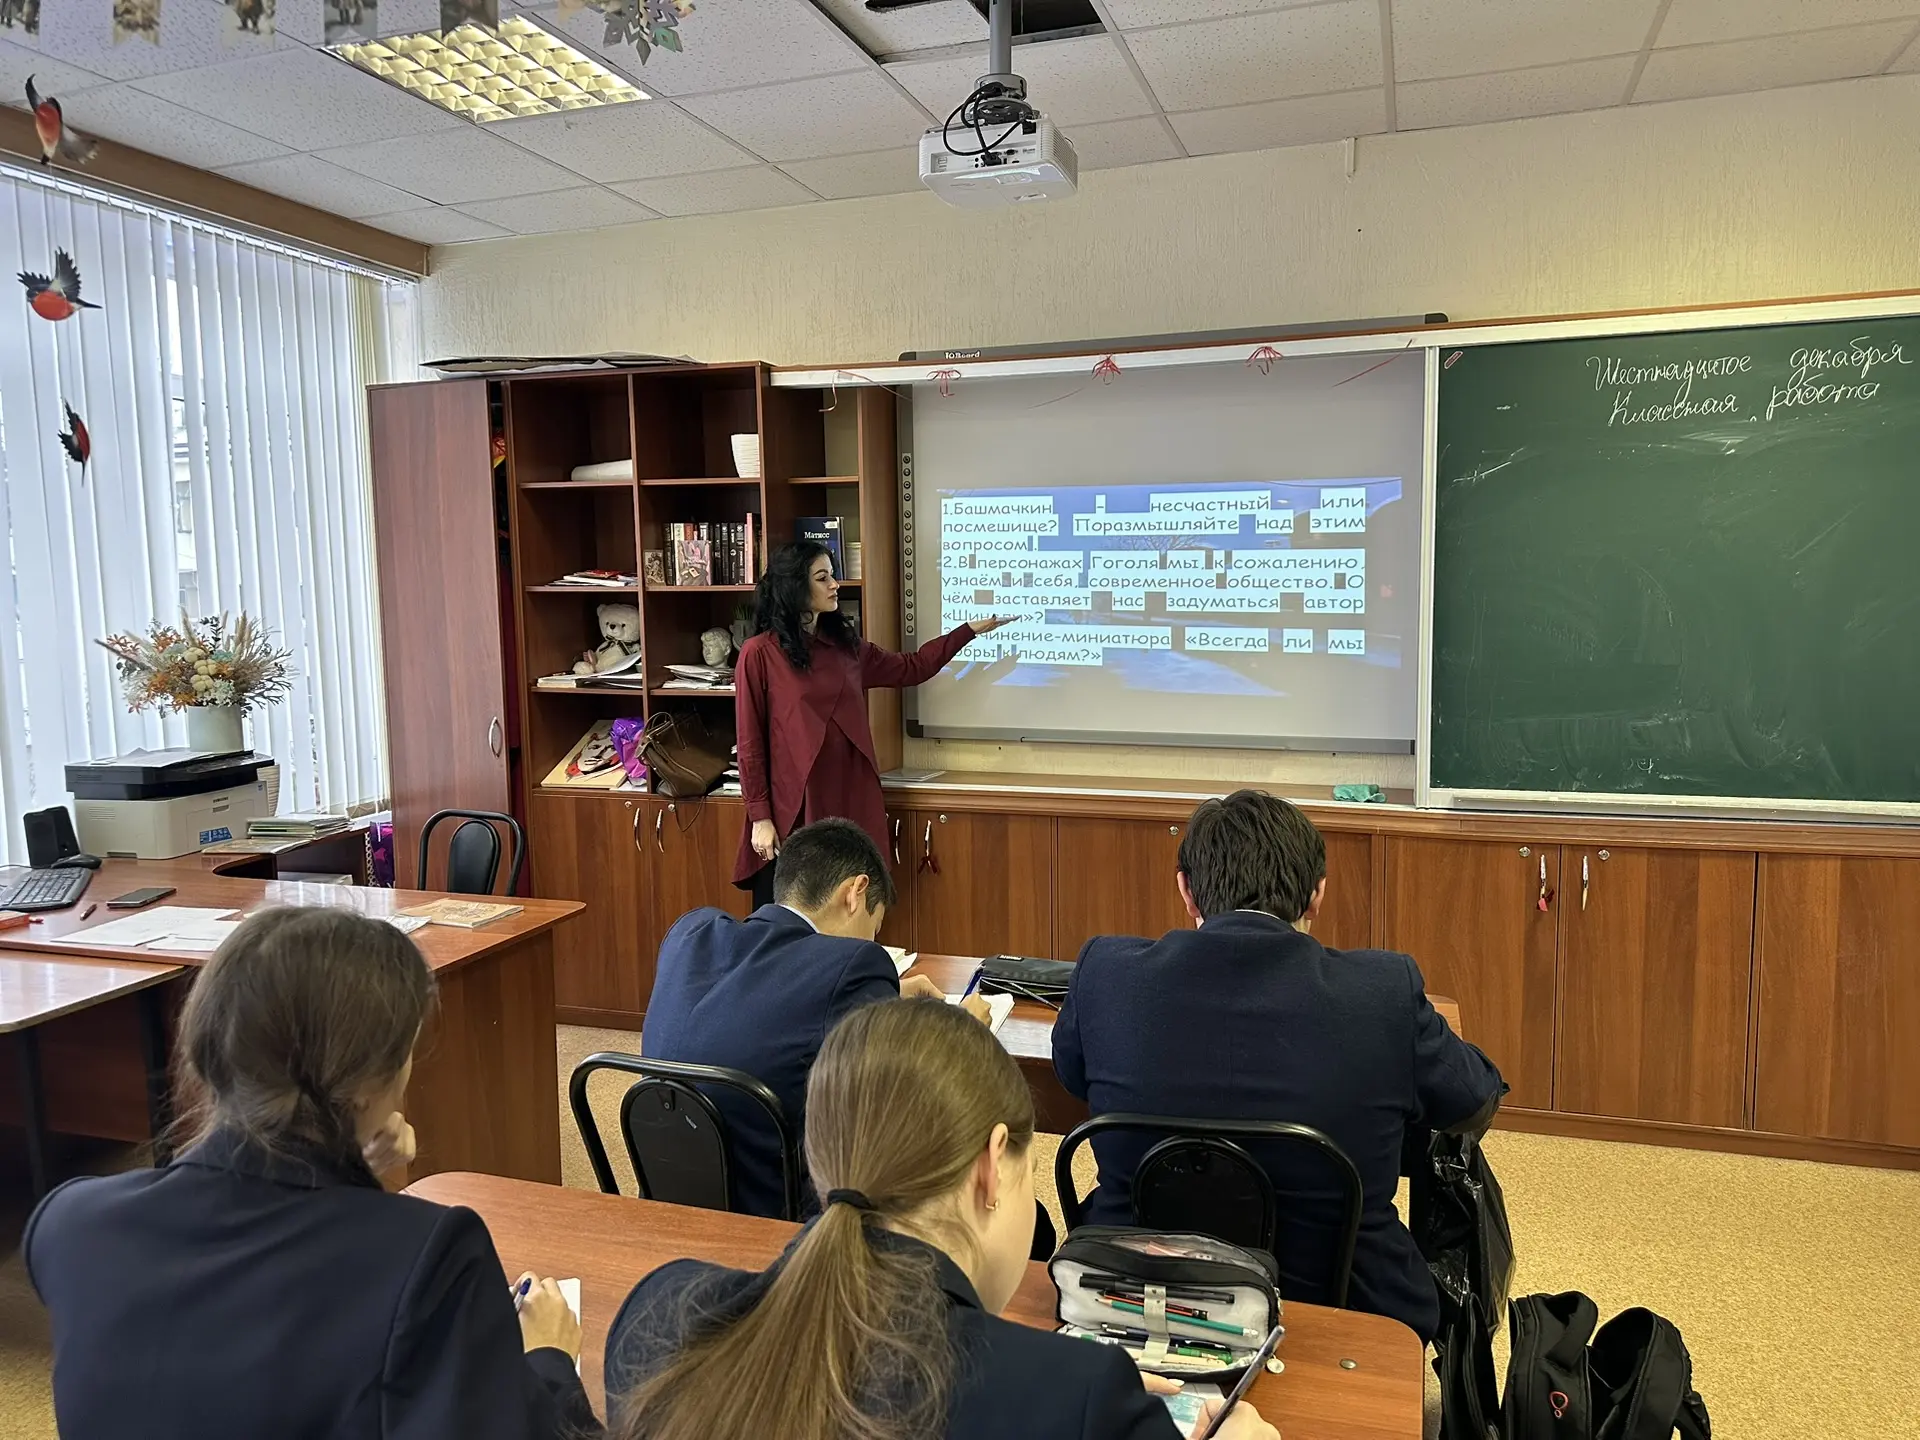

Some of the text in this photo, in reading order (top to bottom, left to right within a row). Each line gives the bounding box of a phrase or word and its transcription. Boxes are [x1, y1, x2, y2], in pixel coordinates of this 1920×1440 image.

[1788, 336, 1912, 390] декабря
[1767, 373, 1880, 420] работа
[942, 502, 1052, 515] 1.Башмачкин
[1150, 496, 1270, 512] несчастный
[1321, 497, 1364, 508] или
[943, 516, 1365, 535] посмешище? Поразмышляйте над этим
[804, 531, 830, 539] Матисс
[977, 558, 1082, 571] персонажах
[1092, 556, 1158, 569] Гоголя
[1168, 559, 1205, 570] мы,
[1214, 559, 1224, 568] к
[1233, 557, 1365, 570] сожалению,
[942, 574, 1364, 590] узнаём и себя, современное общество. О
[942, 591, 1364, 613] чём заставляет нас задуматься автор
[1186, 633, 1268, 648] «Всегда
[1284, 638, 1311, 648] ли
[1329, 639, 1364, 650] мы
[1018, 648, 1101, 662] людям?»
